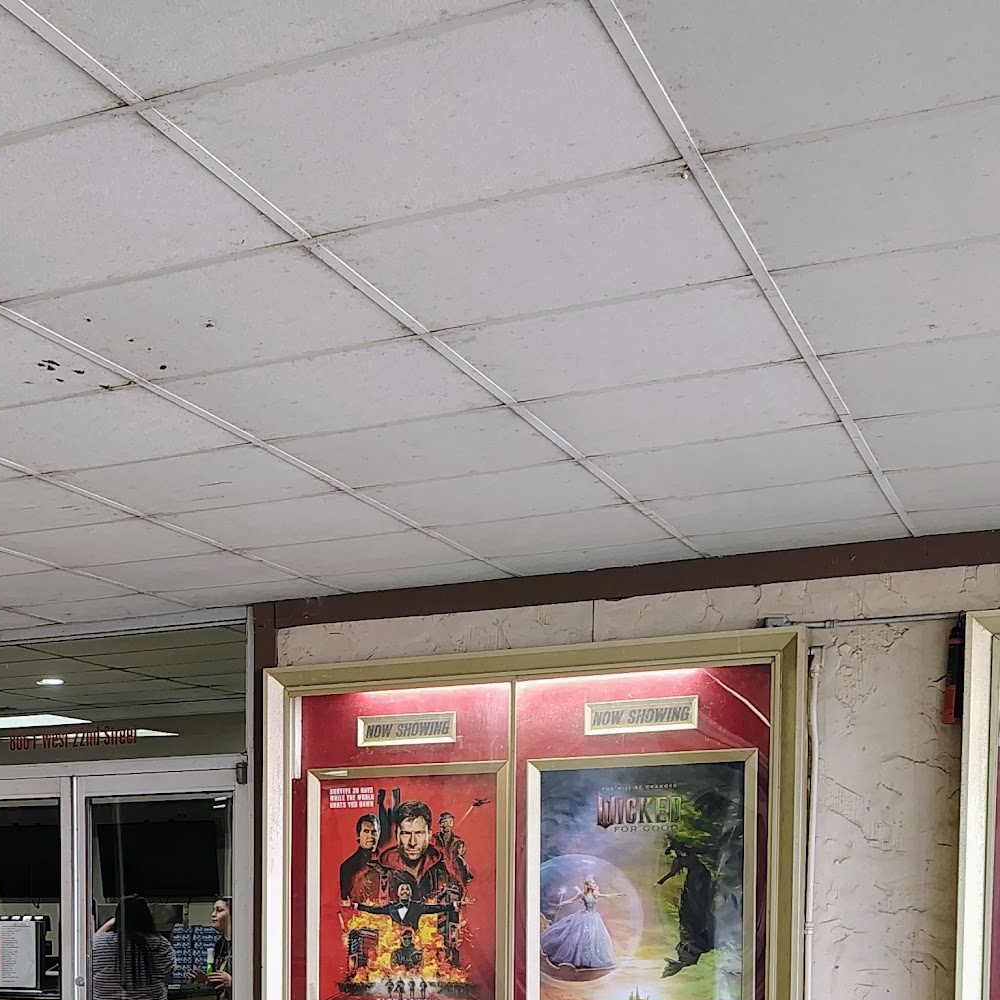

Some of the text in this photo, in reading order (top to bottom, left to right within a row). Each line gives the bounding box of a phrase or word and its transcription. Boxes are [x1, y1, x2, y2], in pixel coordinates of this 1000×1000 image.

[592, 706, 690, 727] NOW SHOWING
[365, 719, 451, 739] NOW SHOWING
[596, 792, 682, 829] WICKED
[614, 824, 679, 833] FOR GOOD
